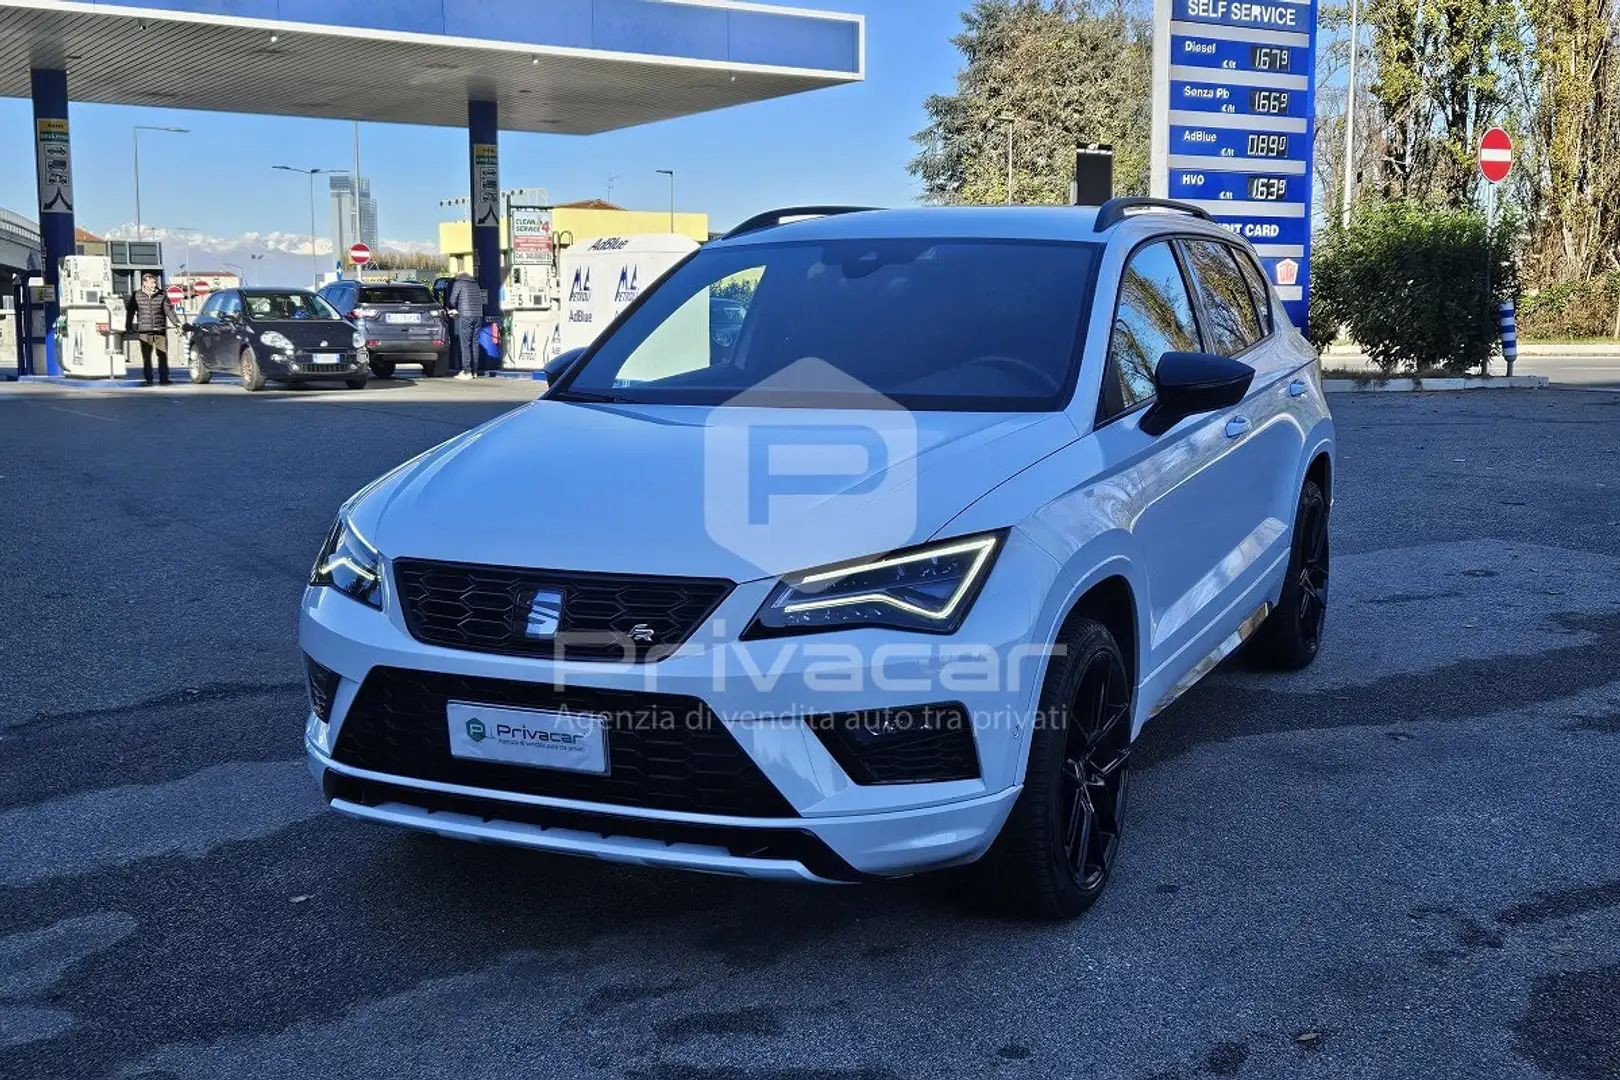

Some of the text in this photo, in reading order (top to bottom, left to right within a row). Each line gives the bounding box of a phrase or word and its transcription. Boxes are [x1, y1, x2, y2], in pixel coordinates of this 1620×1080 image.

[1188, 0, 1296, 25] SELF SERVICE
[1185, 41, 1216, 54] Diesel
[1184, 86, 1230, 99] Senza Pb
[1183, 130, 1217, 143] AdBlue
[1182, 174, 1205, 185] HVO
[1246, 223, 1279, 237] CARD
[587, 236, 629, 252] AdBlue
[568, 308, 593, 323] AdBlue
[496, 724, 584, 744] Privacar
